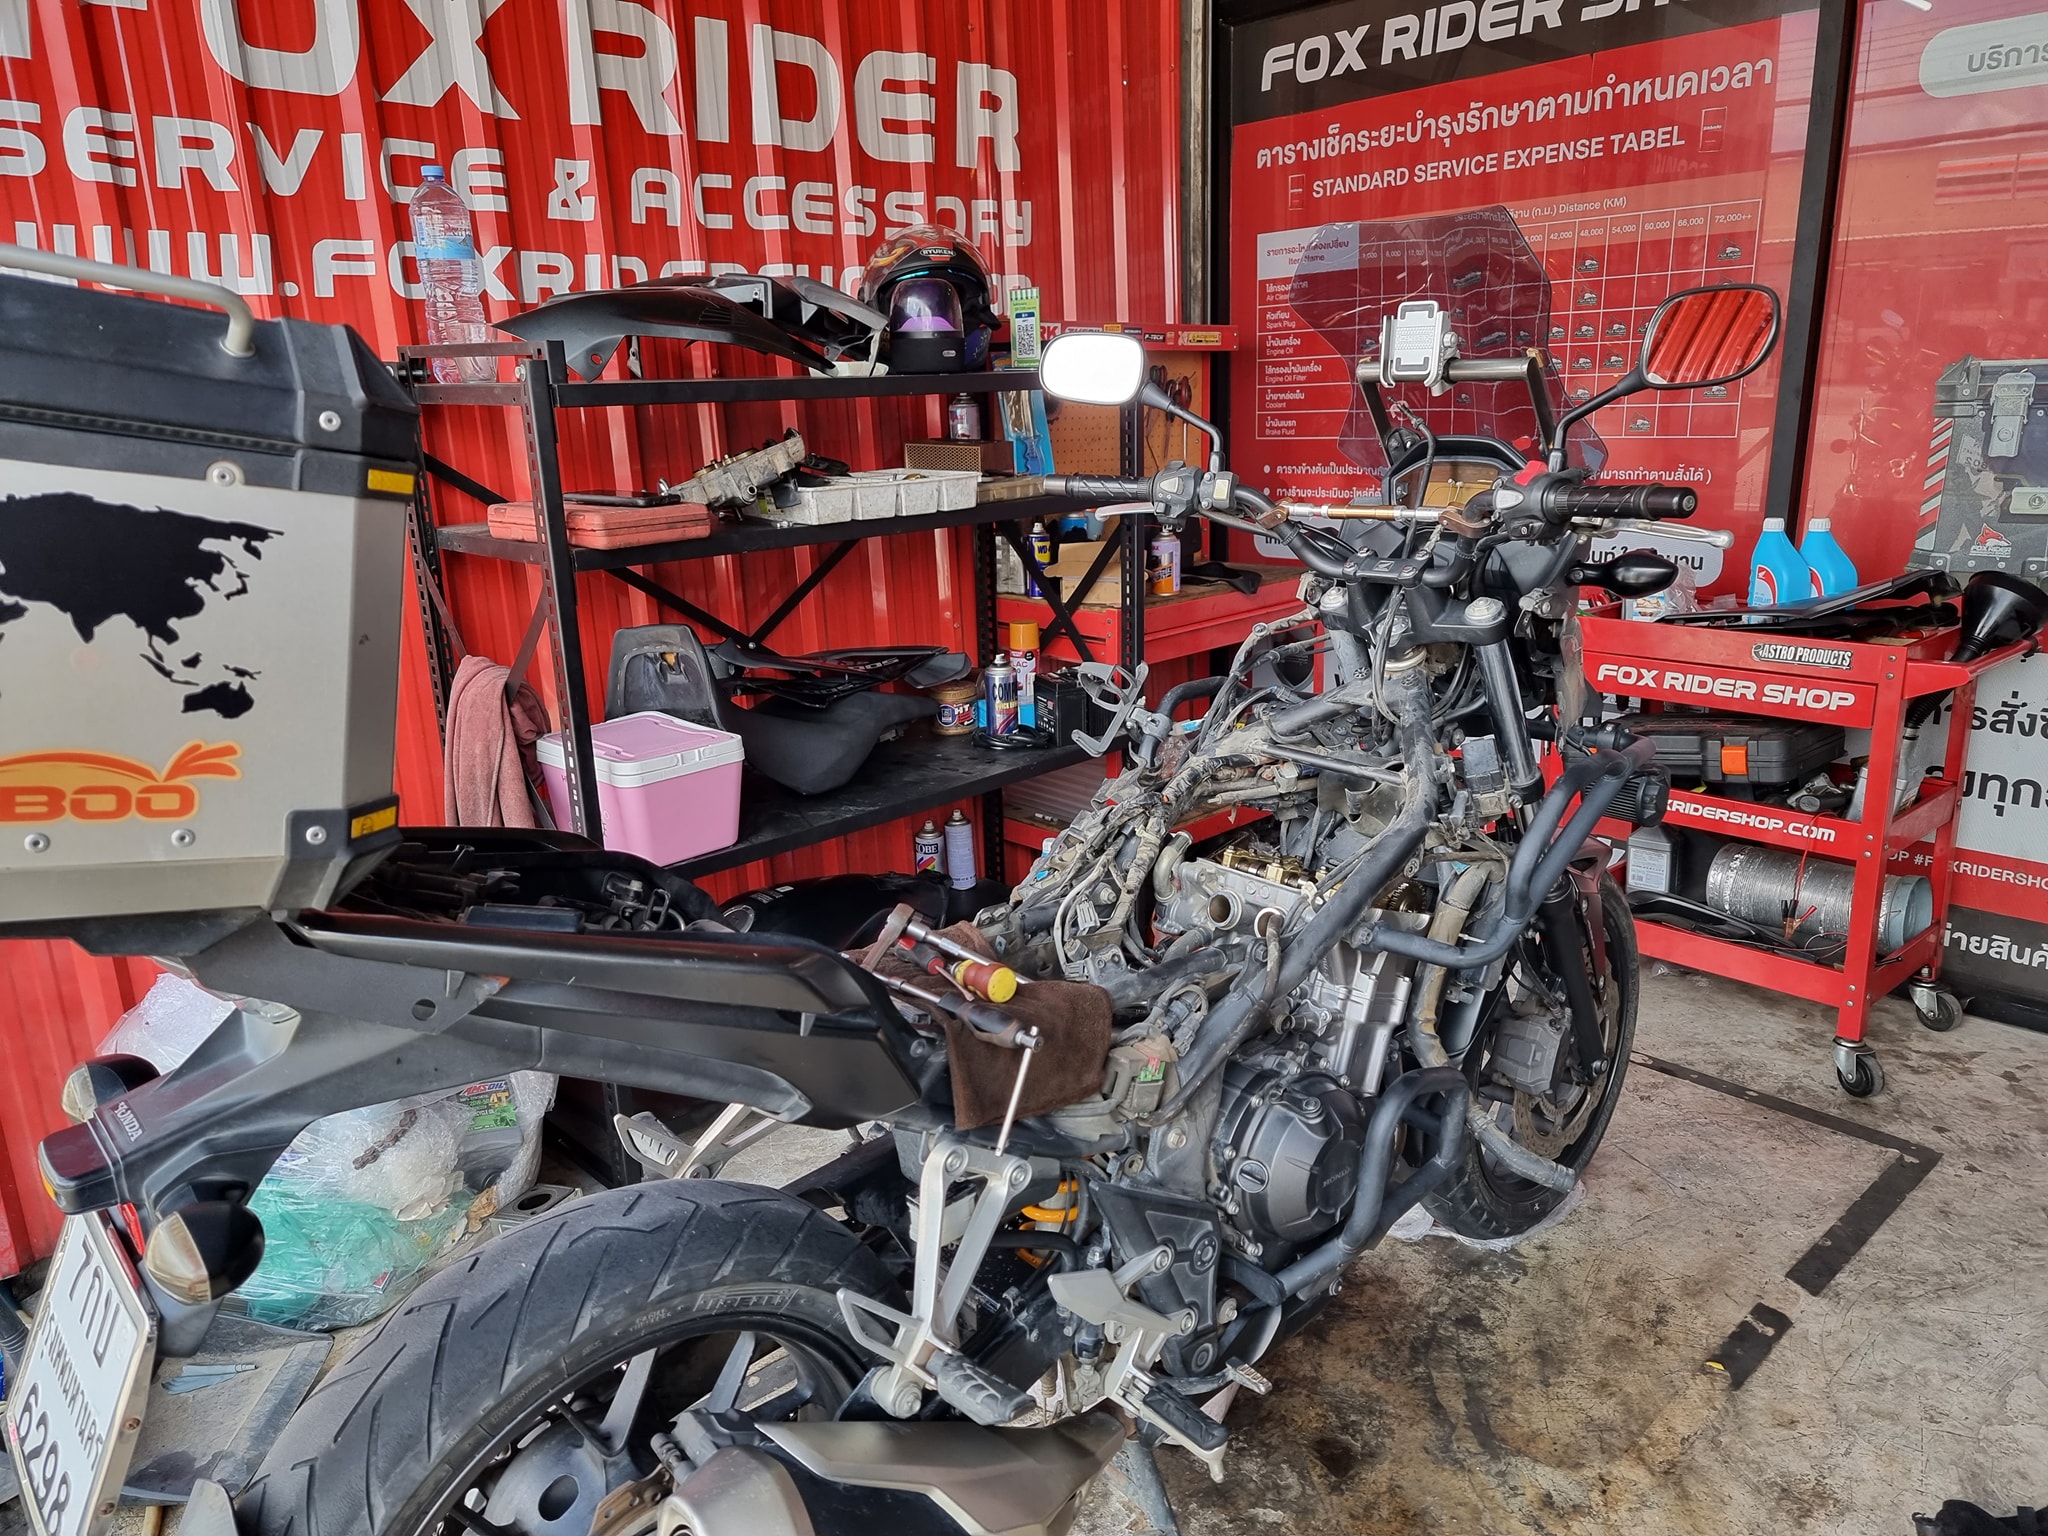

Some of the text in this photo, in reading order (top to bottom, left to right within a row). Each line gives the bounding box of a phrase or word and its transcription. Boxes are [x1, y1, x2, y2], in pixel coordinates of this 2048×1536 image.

[1261, 0, 1563, 91] FOX RIDER
[567, 0, 1022, 172] RIDER
[1256, 57, 1773, 169] ตารางเช็คระยะบำรุงรักษาตามกำหนดเวลา
[0, 100, 509, 213] SERVICE
[548, 158, 595, 221] &
[1312, 124, 1686, 198] STANDARD SERVICE EXPENSE TABEL
[1559, 201, 1601, 214] Distance
[1603, 196, 1627, 209] (KM)
[1549, 231, 1573, 241] 42,000
[1579, 227, 1604, 238] 48,000
[1611, 224, 1637, 235] 54,000
[1644, 220, 1670, 231] 60,000
[1677, 216, 1705, 228] 66,000
[1266, 320, 1296, 329] Spark Plug
[1266, 348, 1284, 356] Engine
[1265, 375, 1283, 383] Engine
[1761, 644, 1852, 667] ASTRO PRODUCTS
[1597, 663, 1856, 712] FOX RIDER SHOP
[489, 1091, 510, 1108] 4T
[114, 1101, 143, 1142] HONDA
[18, 1381, 73, 1536] 6298
